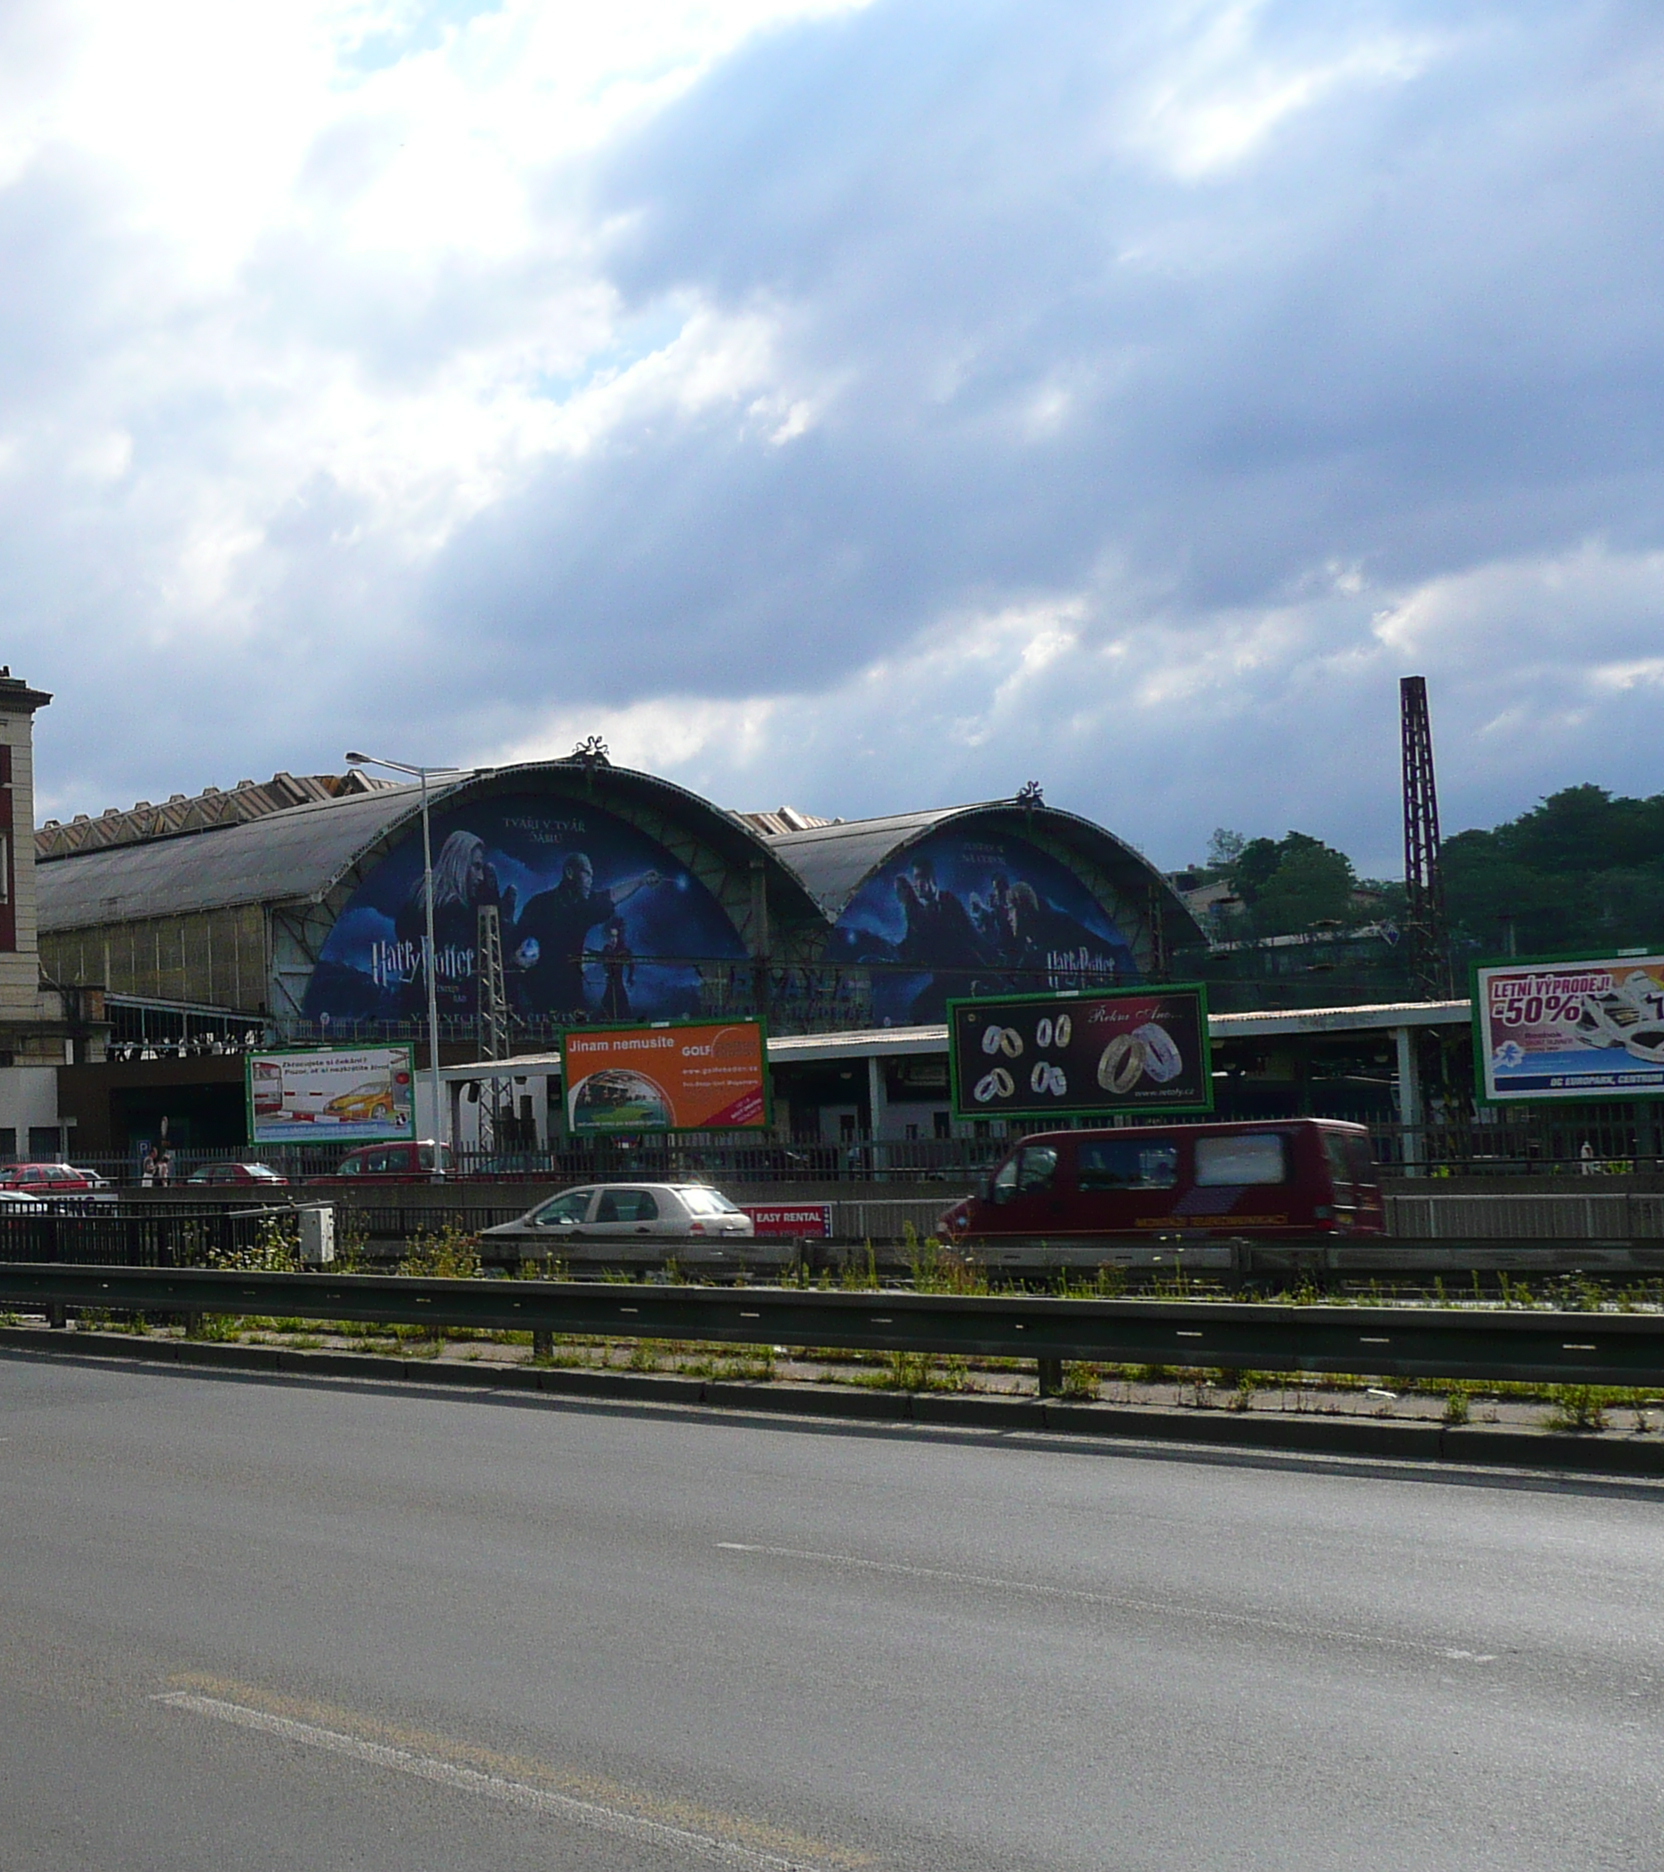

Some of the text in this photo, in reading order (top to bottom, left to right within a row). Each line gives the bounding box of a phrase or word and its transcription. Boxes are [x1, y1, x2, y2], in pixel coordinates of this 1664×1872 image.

[372, 940, 420, 987] Harry
[1494, 975, 1611, 998] LETNÍ VÝPRODEJ!
[1494, 995, 1580, 1025] -50%
[569, 1040, 609, 1052] Jinam
[682, 1045, 711, 1057] GOLF
[756, 1211, 822, 1222] EASY RENTAL
